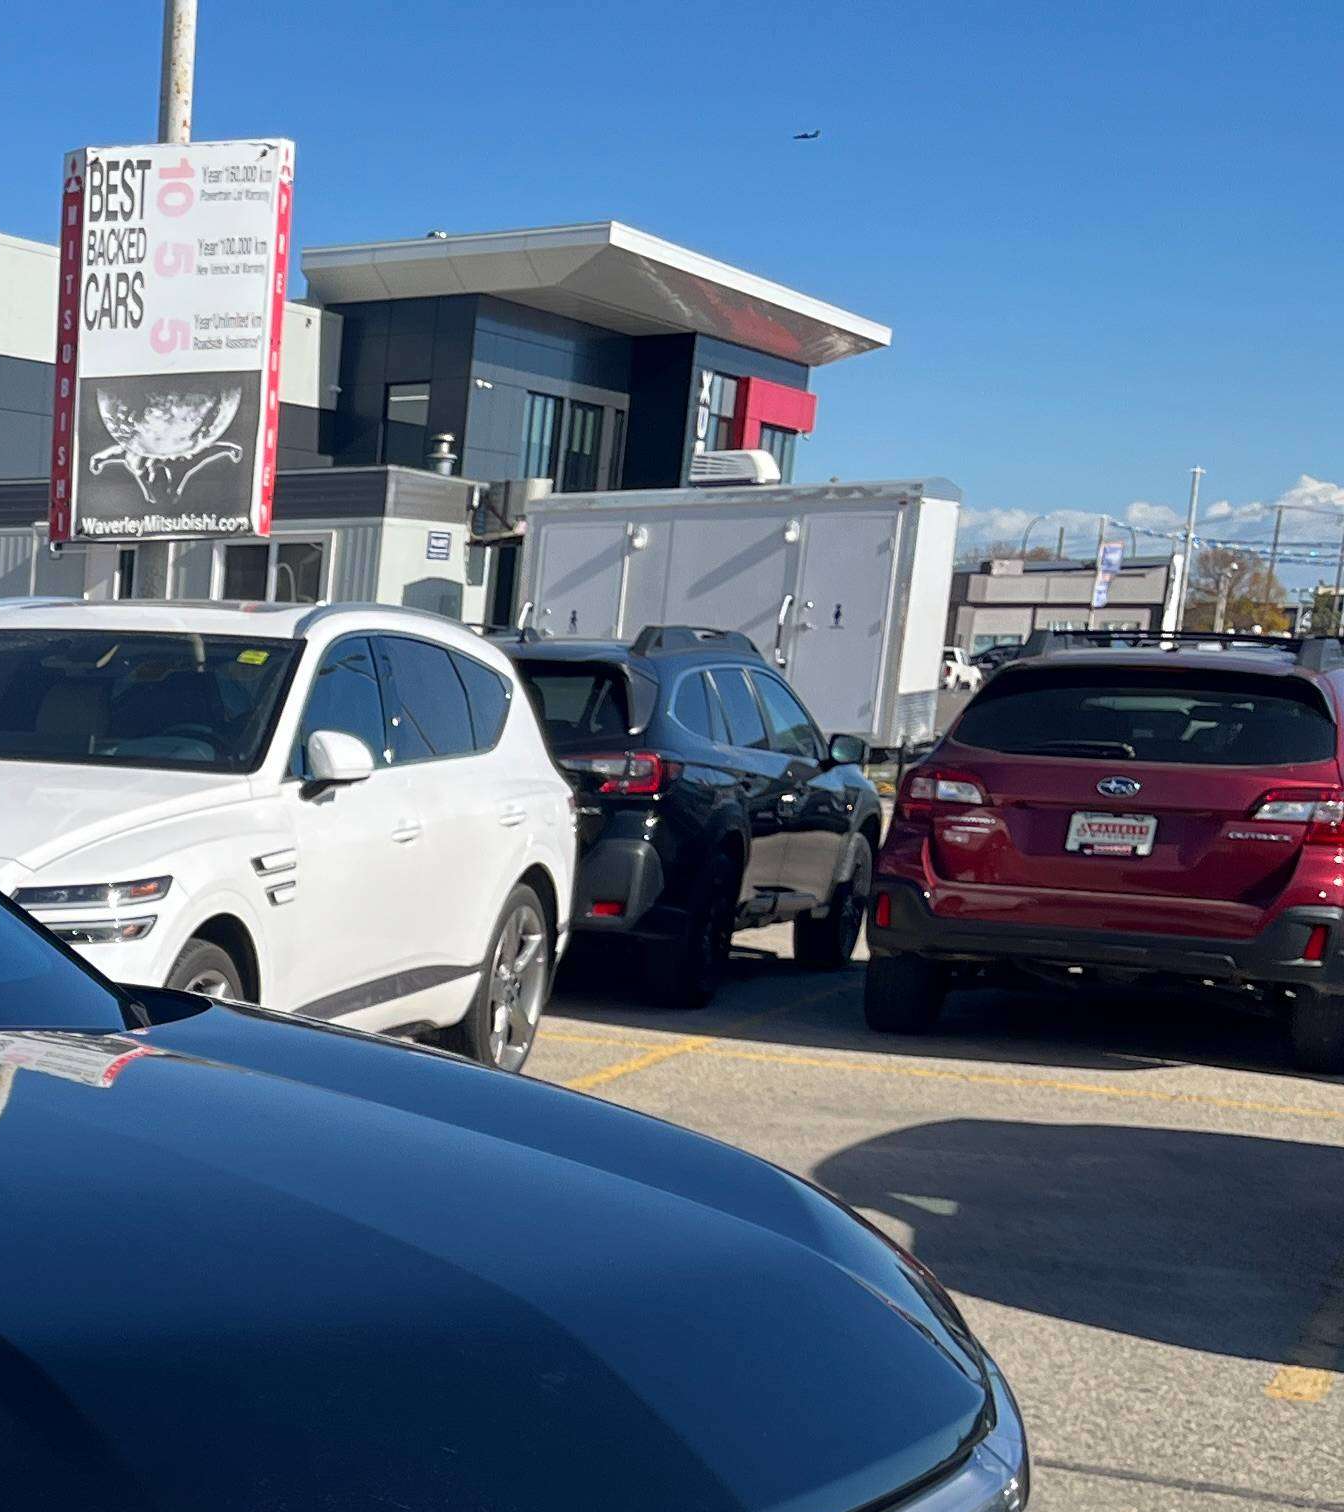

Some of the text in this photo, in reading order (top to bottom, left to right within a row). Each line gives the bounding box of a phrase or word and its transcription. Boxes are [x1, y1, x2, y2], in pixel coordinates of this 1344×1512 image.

[89, 159, 151, 222] BEST
[87, 228, 146, 266] BACKED
[154, 241, 194, 278] 5
[84, 271, 144, 331] CARS
[149, 317, 191, 354] 5
[57, 206, 78, 531] MITSUBISHI
[81, 513, 250, 537] WaverleyMitsubishi.com
